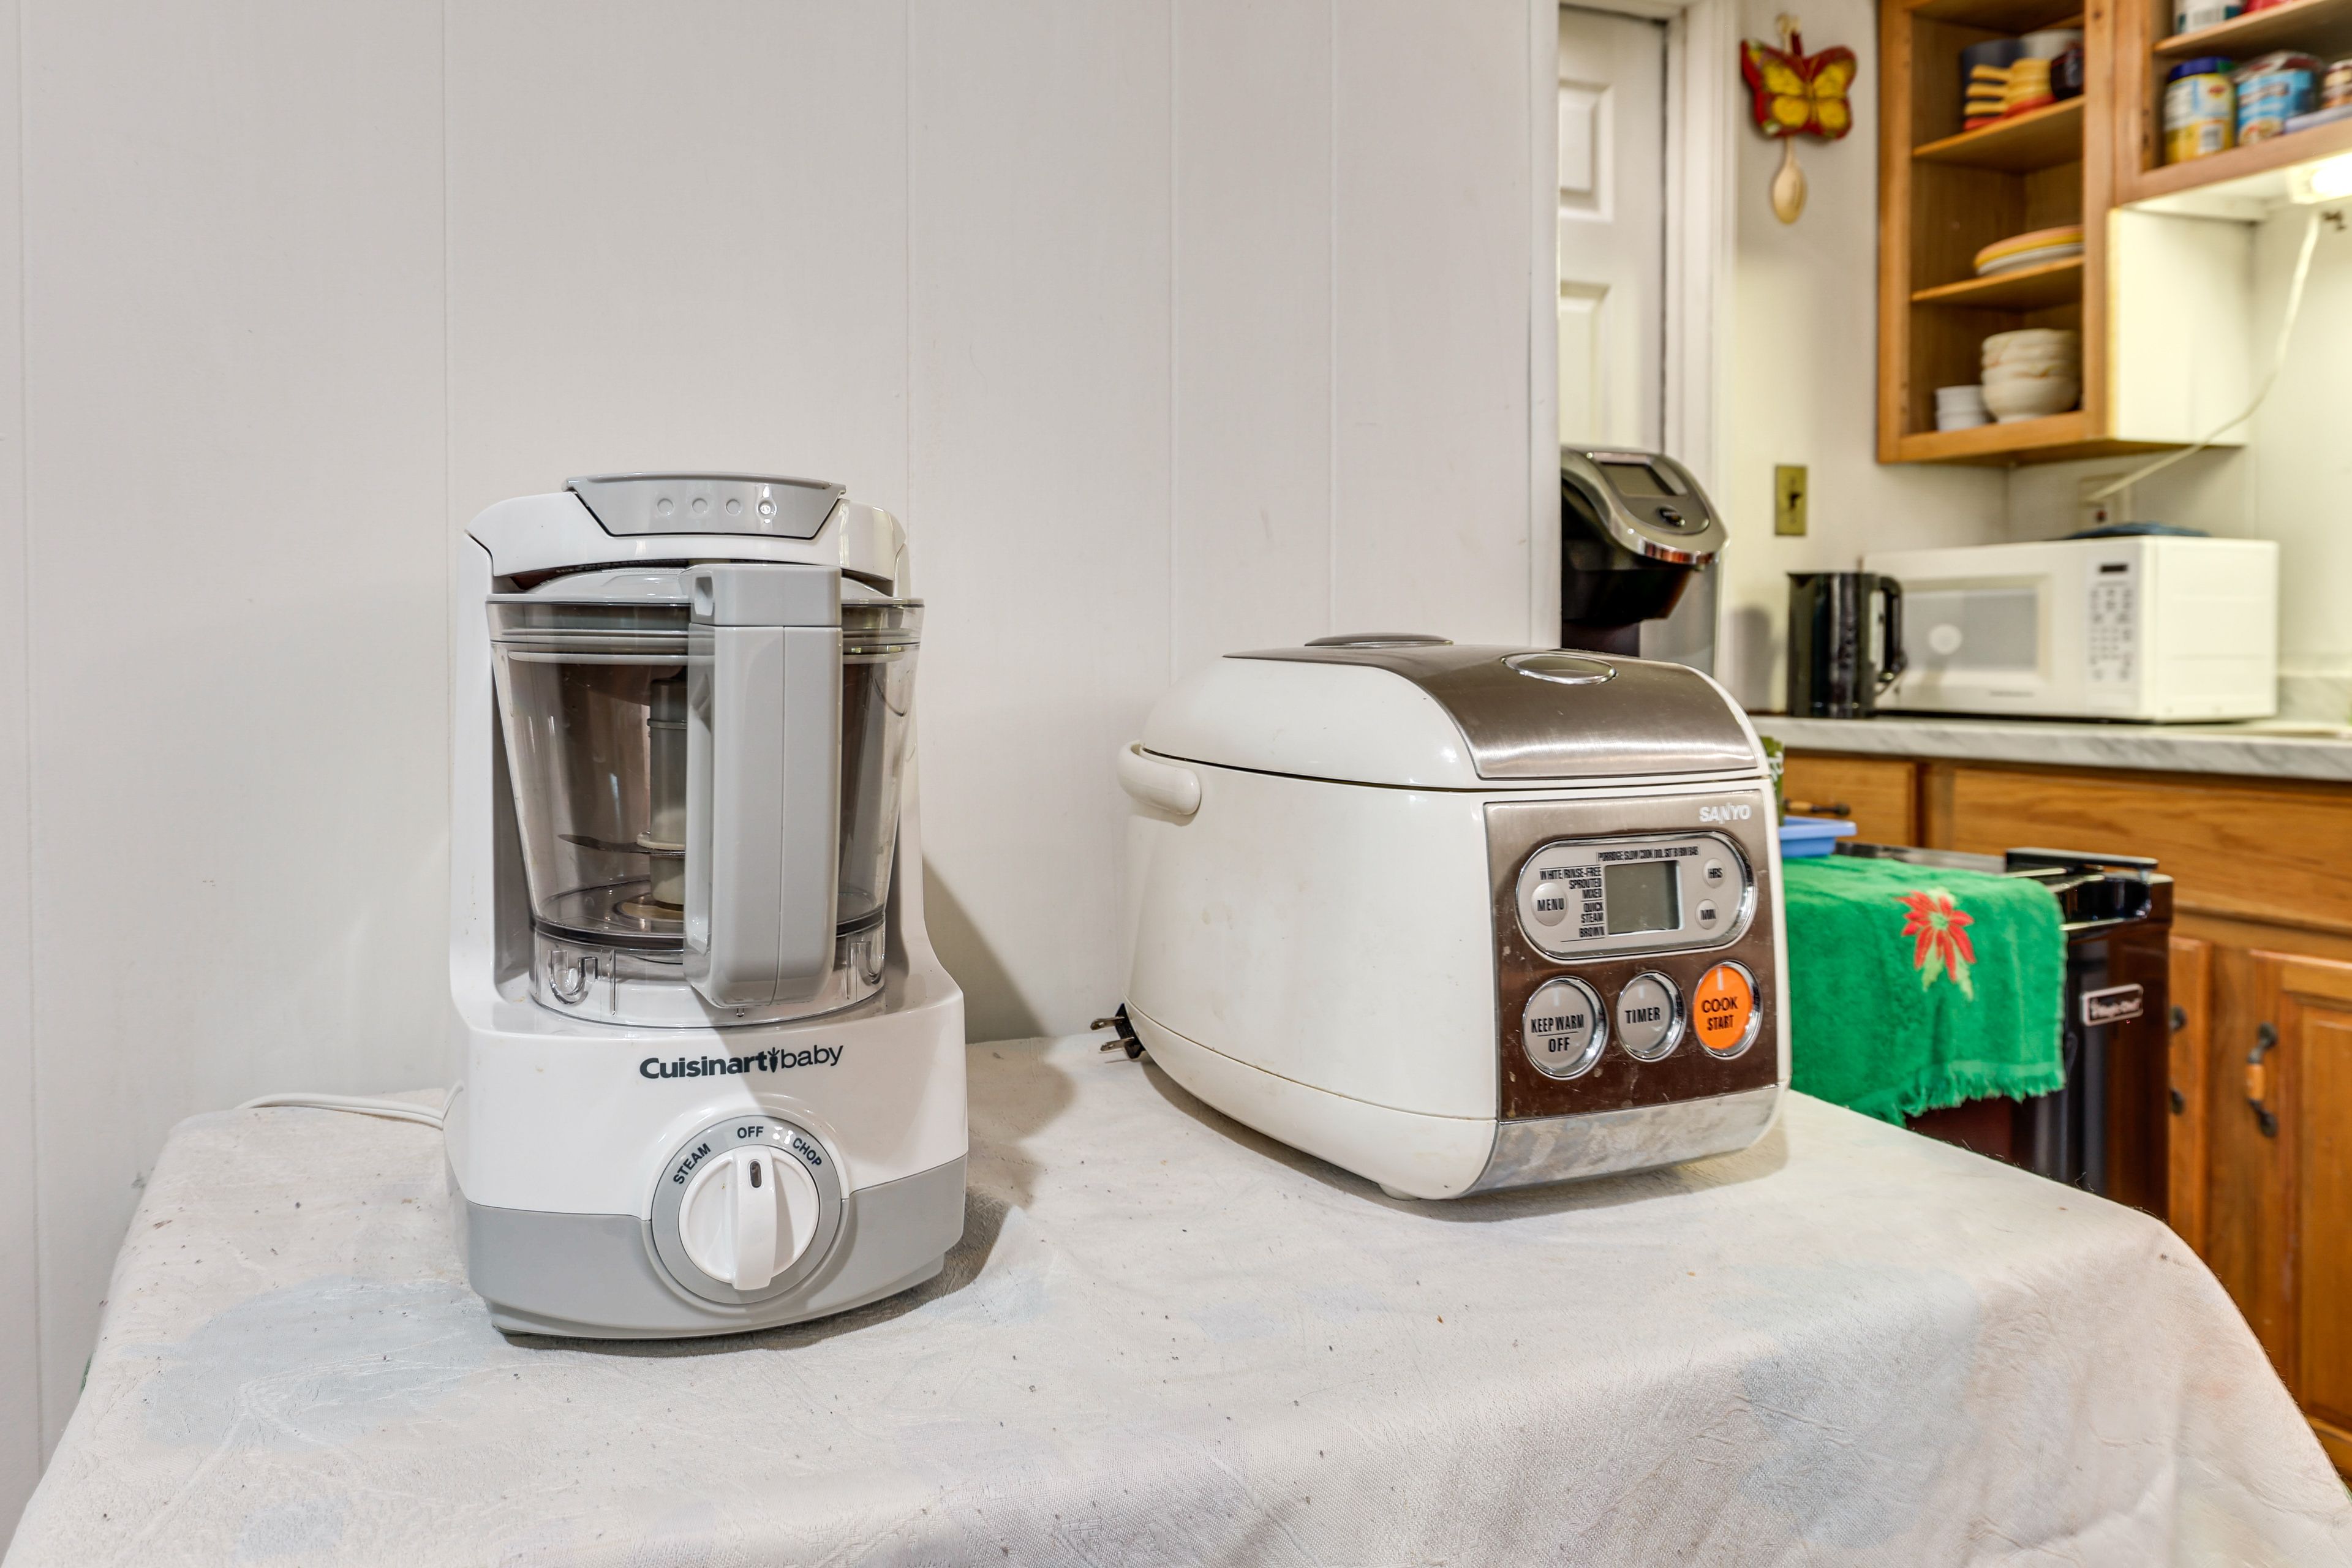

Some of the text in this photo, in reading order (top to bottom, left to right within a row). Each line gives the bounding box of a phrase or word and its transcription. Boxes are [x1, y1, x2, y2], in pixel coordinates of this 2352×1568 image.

[1699, 802, 1752, 824] SANYO
[1708, 867, 1723, 879] HRS
[1569, 878, 1602, 889] SPROUTED
[1582, 888, 1602, 899] MIXED
[1537, 898, 1564, 911] MENU
[1583, 902, 1604, 913] QUICK
[1581, 912, 1604, 923] STEAM
[1578, 926, 1605, 938] BROWN
[1702, 997, 1738, 1012] COOK
[1625, 1007, 1660, 1023] TIMER
[1531, 1014, 1584, 1033] KEEP WARM
[1708, 1015, 1735, 1031] START
[1548, 1037, 1570, 1052] OFF
[639, 1044, 843, 1079] Cuisinart baby
[737, 1126, 764, 1139] OFF
[792, 1137, 822, 1166] CHOP
[673, 1143, 711, 1184] STEAM
